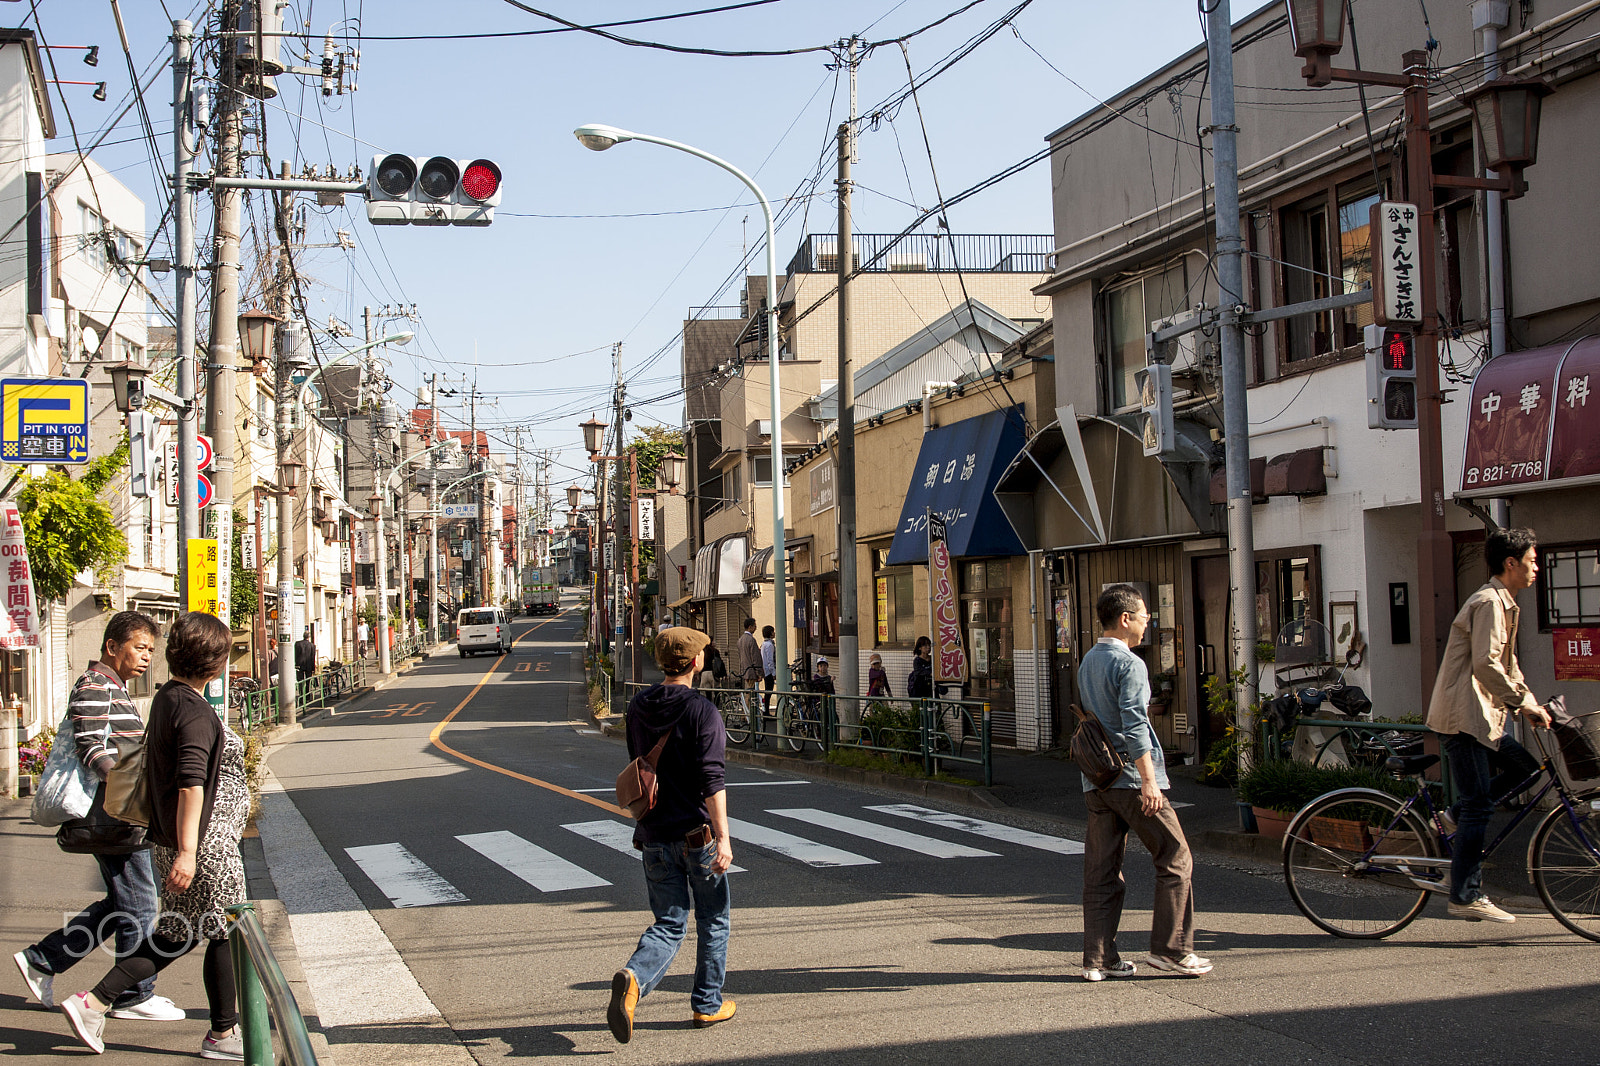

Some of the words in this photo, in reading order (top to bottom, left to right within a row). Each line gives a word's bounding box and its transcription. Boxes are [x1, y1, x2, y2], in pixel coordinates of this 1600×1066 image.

[1388, 208, 1414, 223] 谷中
[1392, 223, 1415, 319] さんさき坂
[24, 425, 43, 434] PIT
[46, 425, 58, 434] IN
[62, 426, 82, 434] 100
[22, 436, 65, 455] 空車
[70, 435, 85, 448] IN
[924, 453, 975, 488] 朝日湯
[1482, 461, 1542, 482] 821-7768
[1568, 640, 1592, 656] 日展
